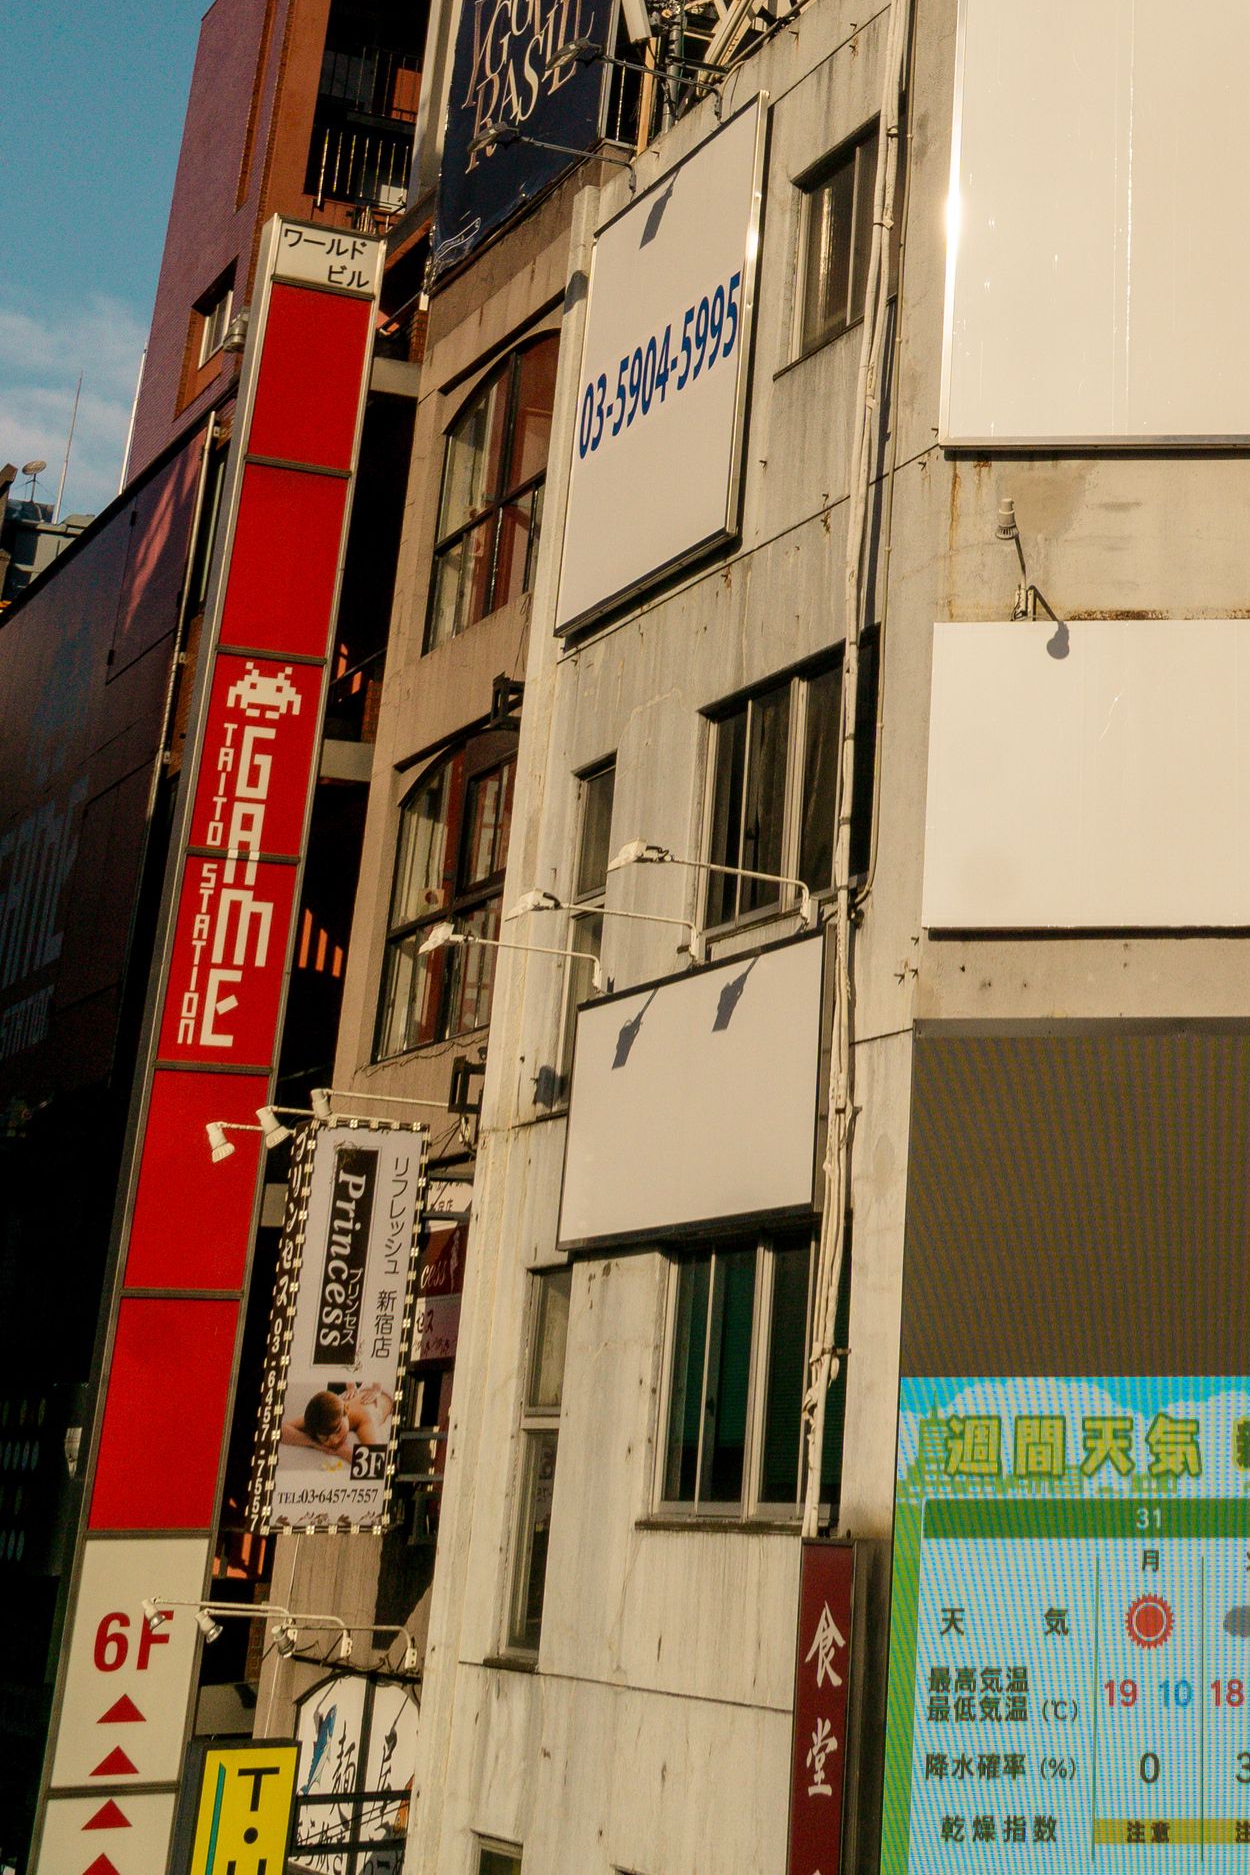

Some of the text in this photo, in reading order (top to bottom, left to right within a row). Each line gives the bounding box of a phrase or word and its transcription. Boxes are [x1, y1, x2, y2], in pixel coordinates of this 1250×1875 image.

[283, 228, 368, 260] ワールド
[326, 262, 370, 290] ビル
[580, 271, 741, 460] 03-5904-5995
[206, 722, 238, 846] TAITO
[200, 724, 277, 1048] GAME
[176, 863, 217, 1045] STATION
[319, 1169, 367, 1348] Princess
[371, 1156, 410, 1360] リフレッシュ 新宿店
[341, 1267, 364, 1346] プリンセス
[353, 1445, 386, 1479] 3F
[944, 1412, 1203, 1478] 週間天気
[1135, 1506, 1162, 1529] 31
[1141, 1548, 1160, 1572] 月
[93, 1609, 175, 1674] 6F
[804, 1598, 847, 1798] 食堂
[928, 1666, 1029, 1694] 最高気温
[1104, 1678, 1138, 1708] 19
[1158, 1678, 1193, 1708] 10
[1210, 1678, 1245, 1708] 18
[927, 1695, 1029, 1723] 最低気温
[925, 1752, 1027, 1781] 降水確率
[1040, 1756, 1077, 1781] (%)
[1139, 1751, 1160, 1785] 0
[940, 1814, 1058, 1843] 乾燥指数
[1126, 1819, 1171, 1844] 注意
